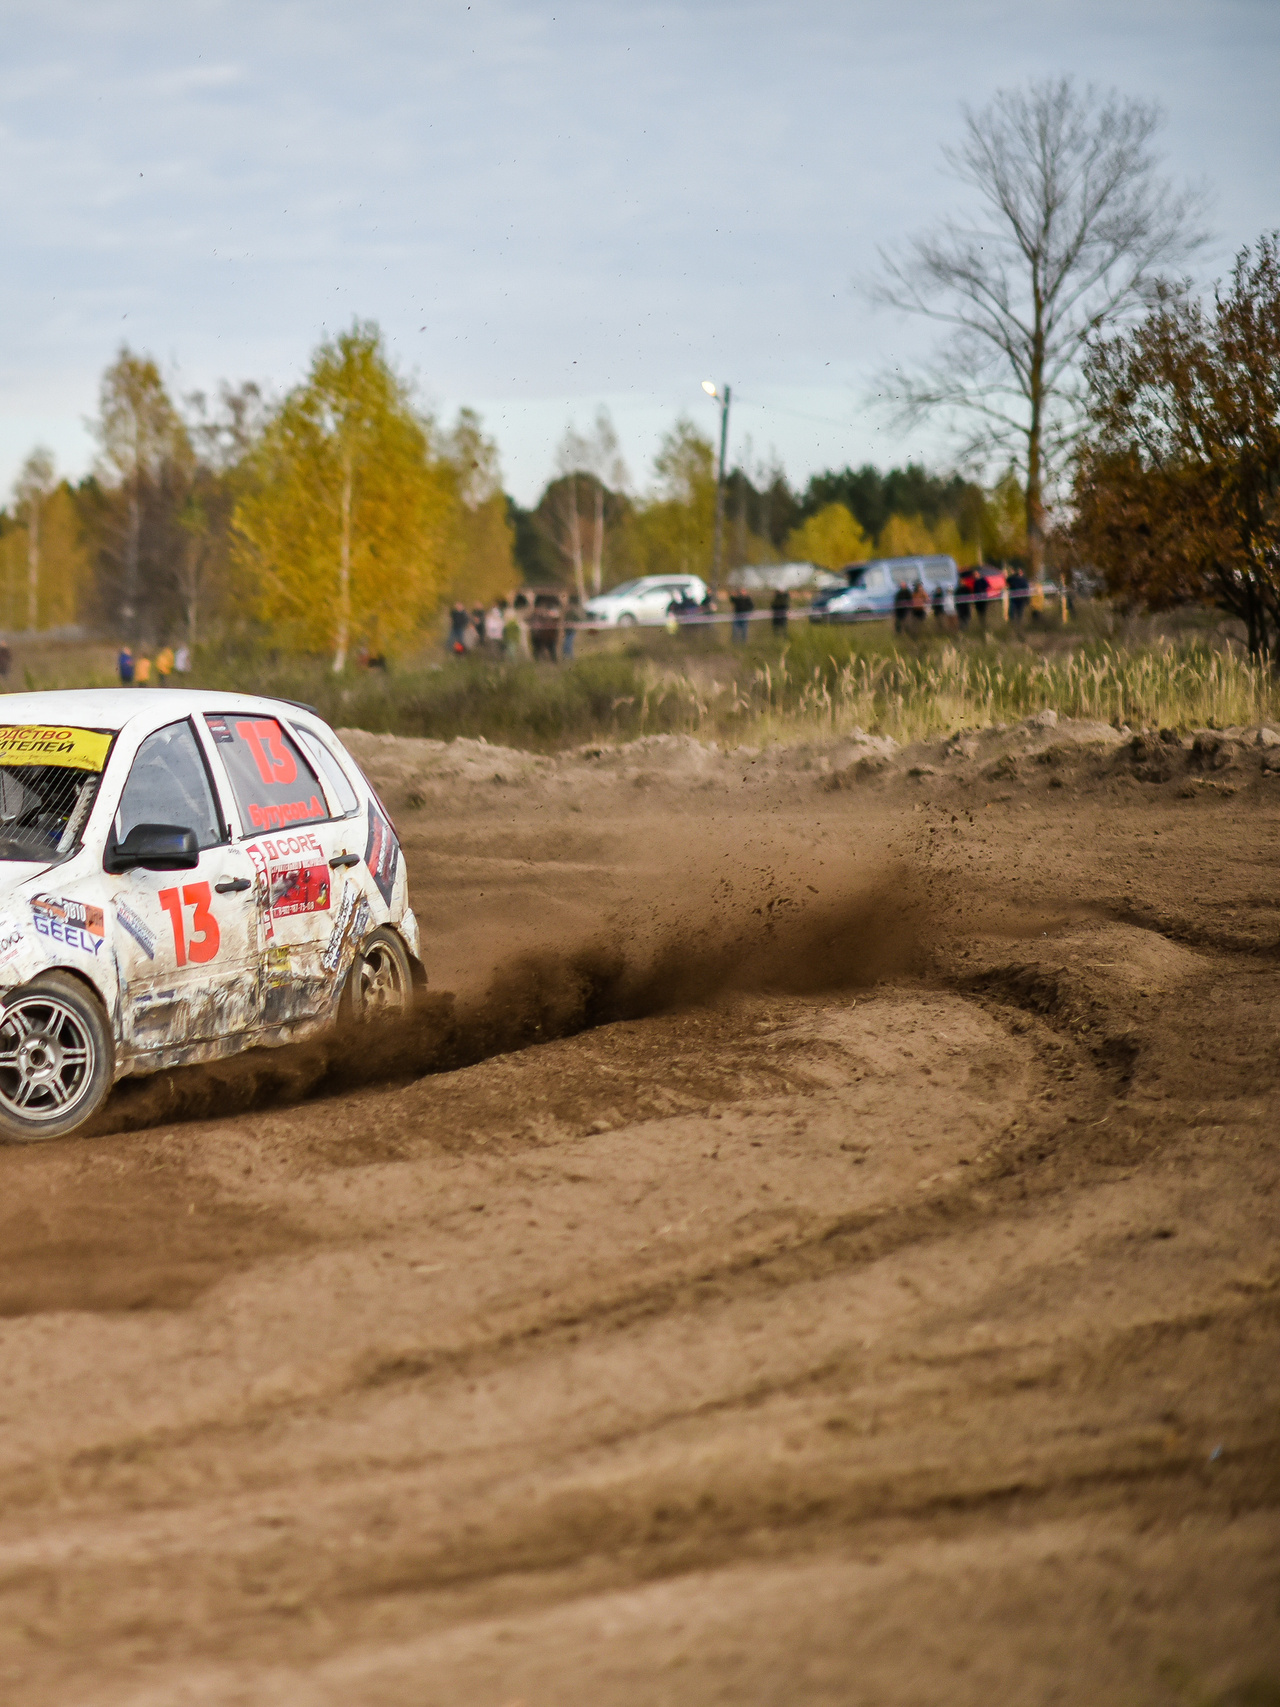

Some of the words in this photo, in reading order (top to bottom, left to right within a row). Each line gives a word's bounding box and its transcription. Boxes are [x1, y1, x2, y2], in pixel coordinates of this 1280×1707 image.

[235, 719, 298, 785] 13
[33, 914, 104, 956] GEELY
[158, 881, 221, 968] 13
